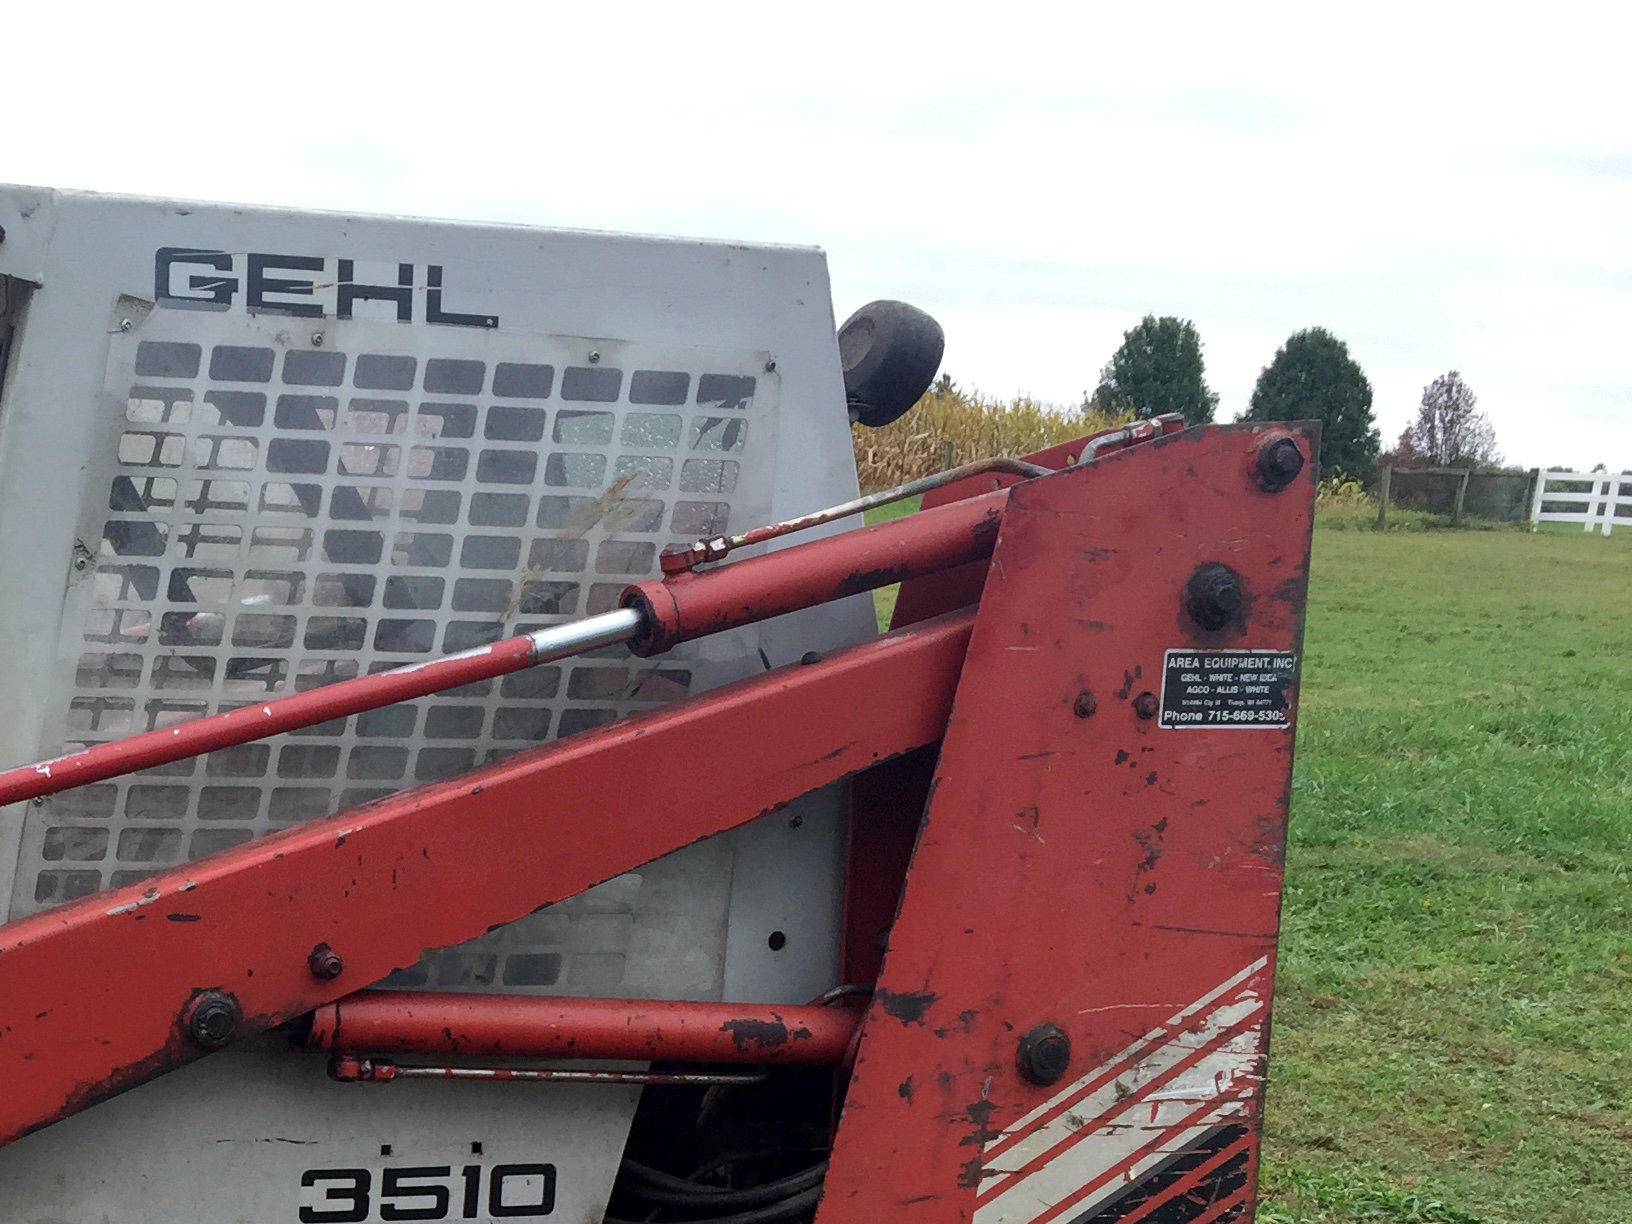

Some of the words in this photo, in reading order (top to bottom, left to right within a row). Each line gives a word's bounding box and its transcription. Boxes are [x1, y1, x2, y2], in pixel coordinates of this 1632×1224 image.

[155, 246, 499, 328] GEHL
[1168, 657, 1200, 668] AREA
[1180, 673, 1202, 682] GEHL
[1209, 673, 1234, 682] WHITE
[1239, 673, 1258, 682] NEW
[1259, 673, 1278, 682] IDEA
[1186, 685, 1210, 694] AGCO
[1216, 685, 1239, 694] ALLIS
[1245, 685, 1270, 694] WHITE
[1164, 710, 1203, 720] Phone
[299, 1163, 557, 1224] 3510
